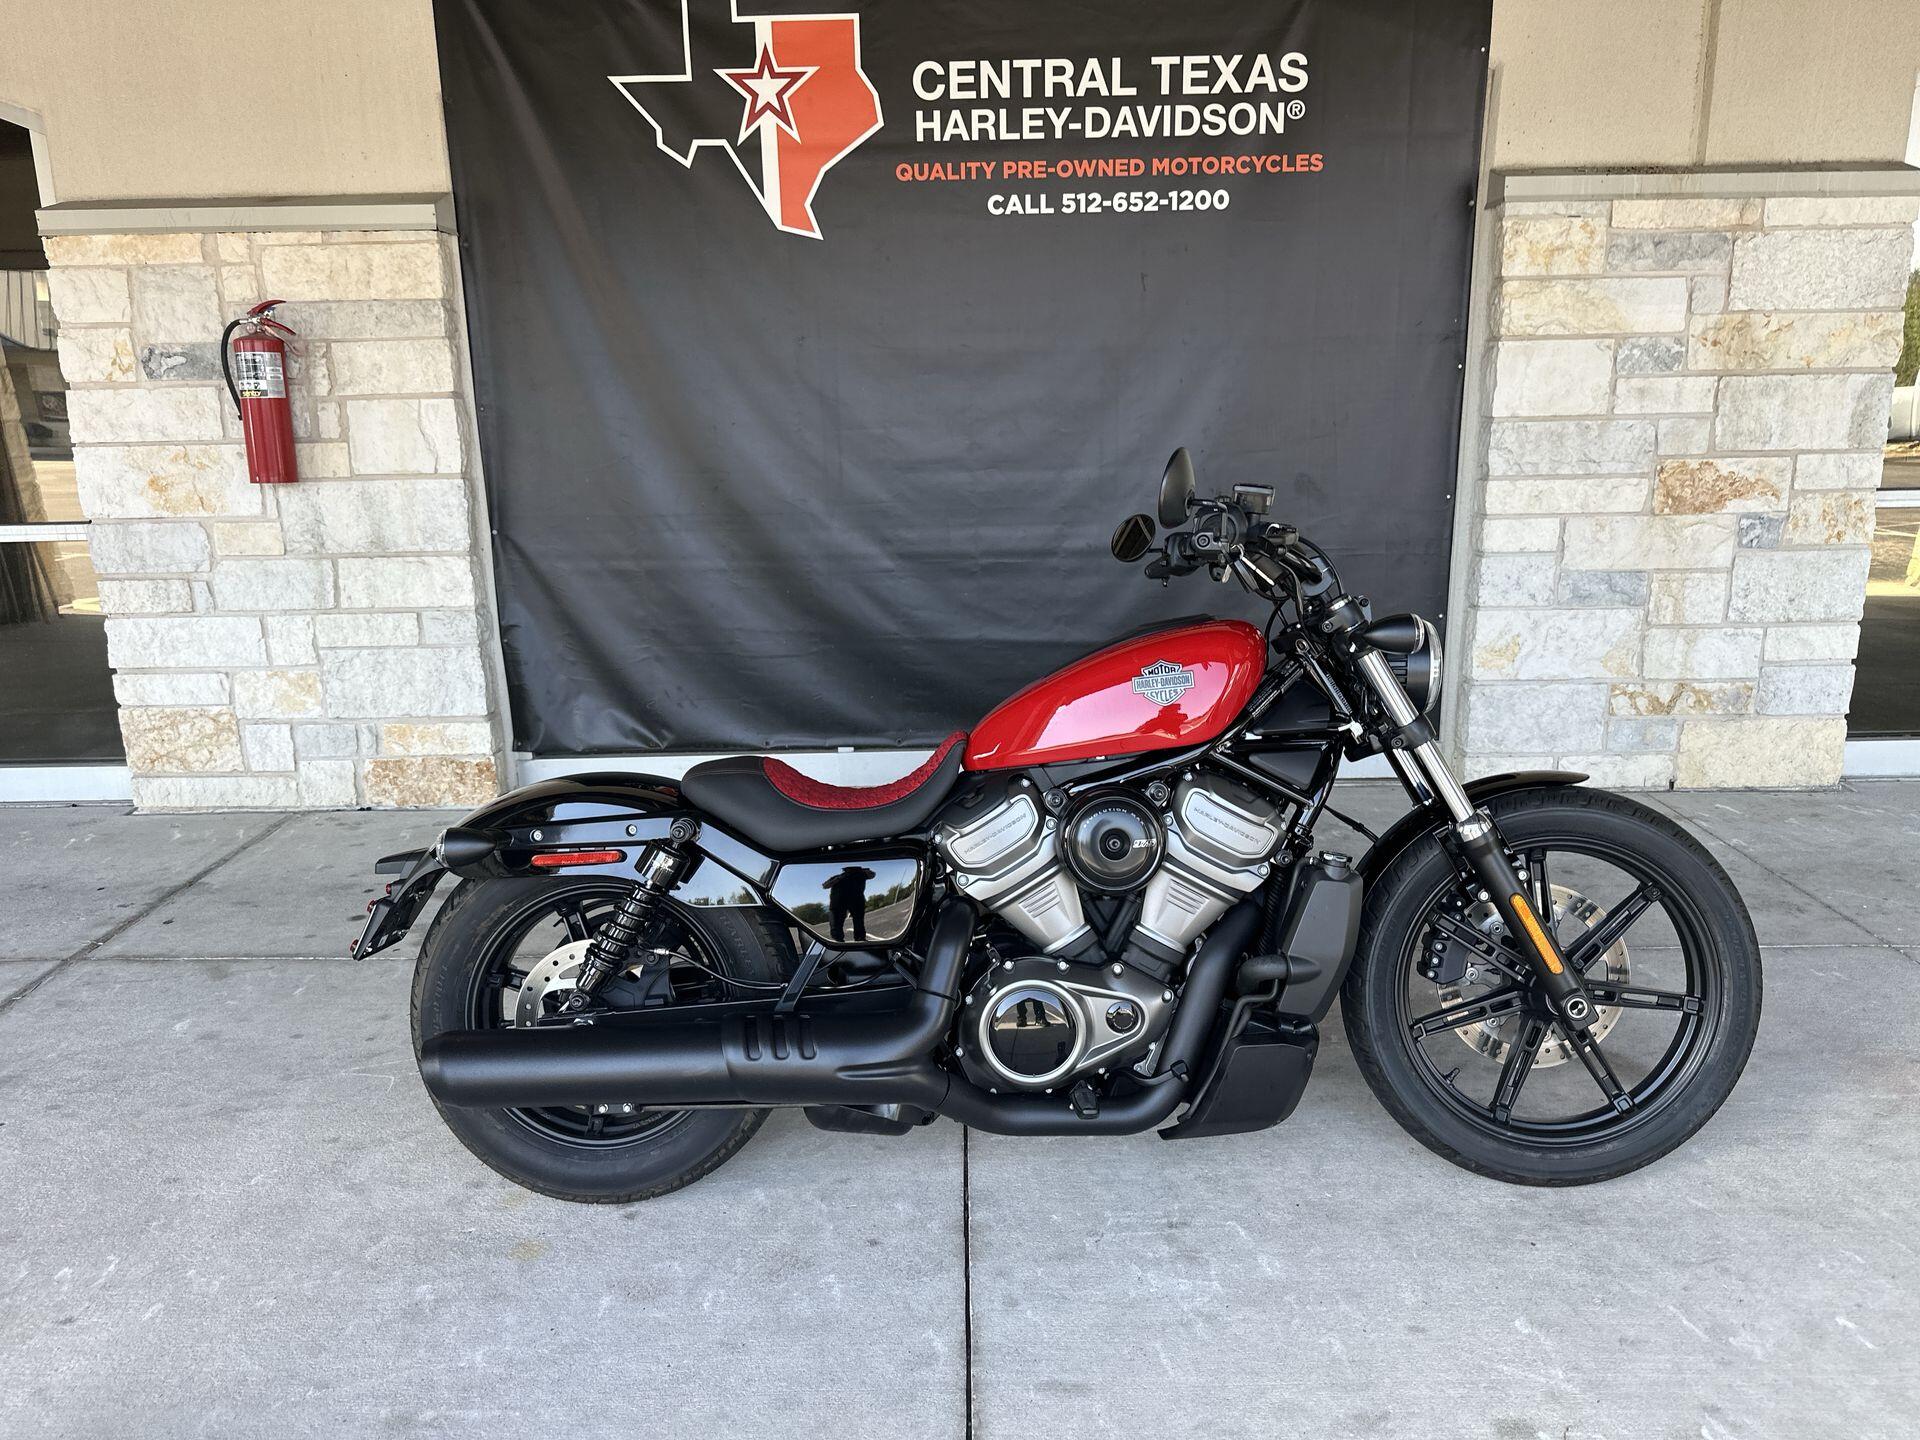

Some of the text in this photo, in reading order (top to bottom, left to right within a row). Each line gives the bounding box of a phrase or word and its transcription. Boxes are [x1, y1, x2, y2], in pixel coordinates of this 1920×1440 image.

[912, 52, 1309, 101] CENTRAL TEXAS
[895, 153, 1324, 181] QUALITY PRE-OWNED MOTORCYCLES
[987, 189, 1230, 215] CALL 512-652-1200
[1148, 665, 1177, 675] MOTOR
[1136, 675, 1191, 690] HARLEY-DAVIDSON
[1149, 688, 1179, 702] CYCLES
